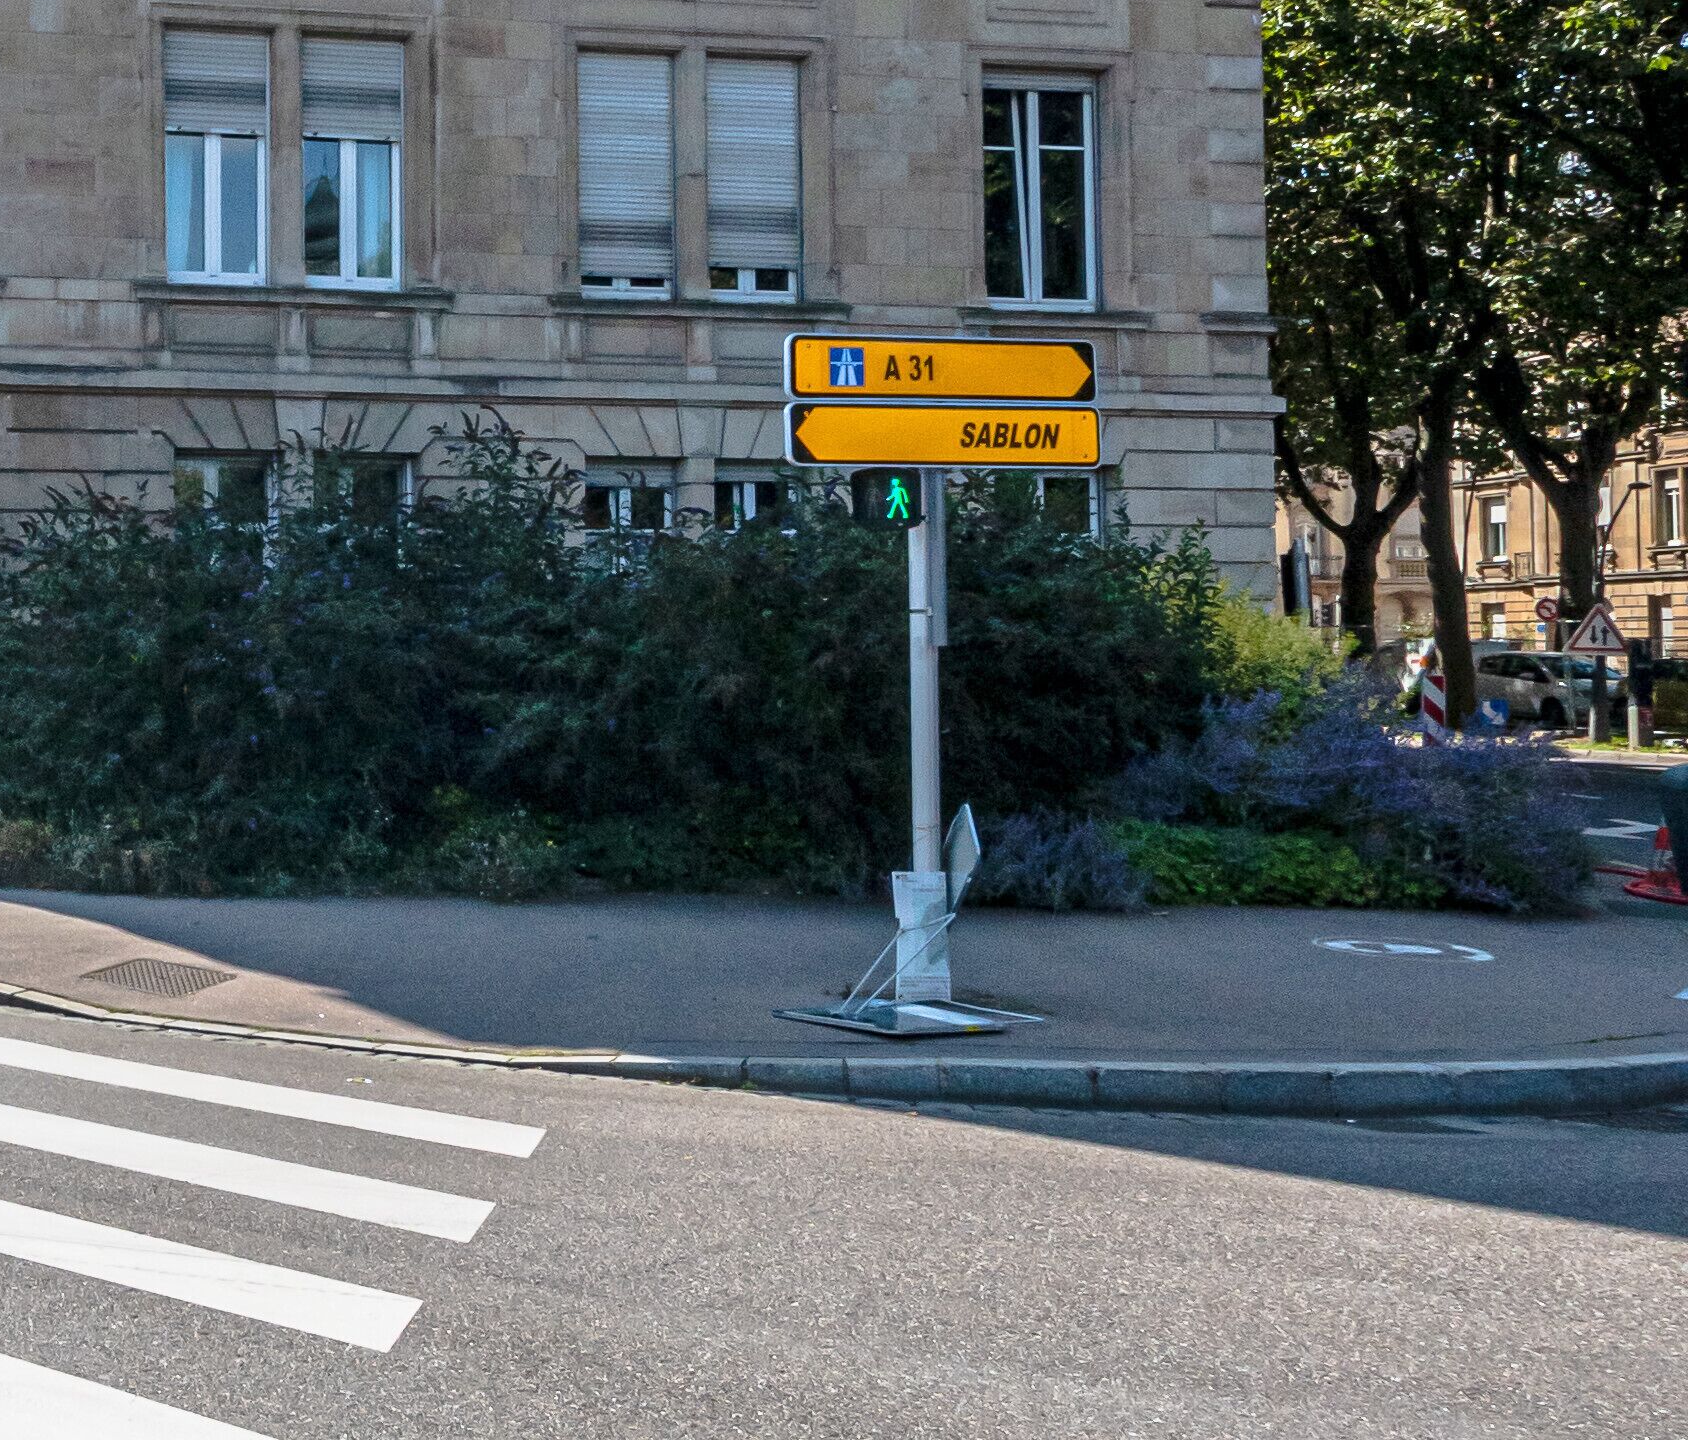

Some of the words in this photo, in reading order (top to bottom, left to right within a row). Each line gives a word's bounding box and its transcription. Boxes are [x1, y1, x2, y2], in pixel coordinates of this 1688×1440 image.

[884, 355, 900, 381] A
[909, 355, 934, 381] 31
[960, 422, 1060, 449] SABLON
